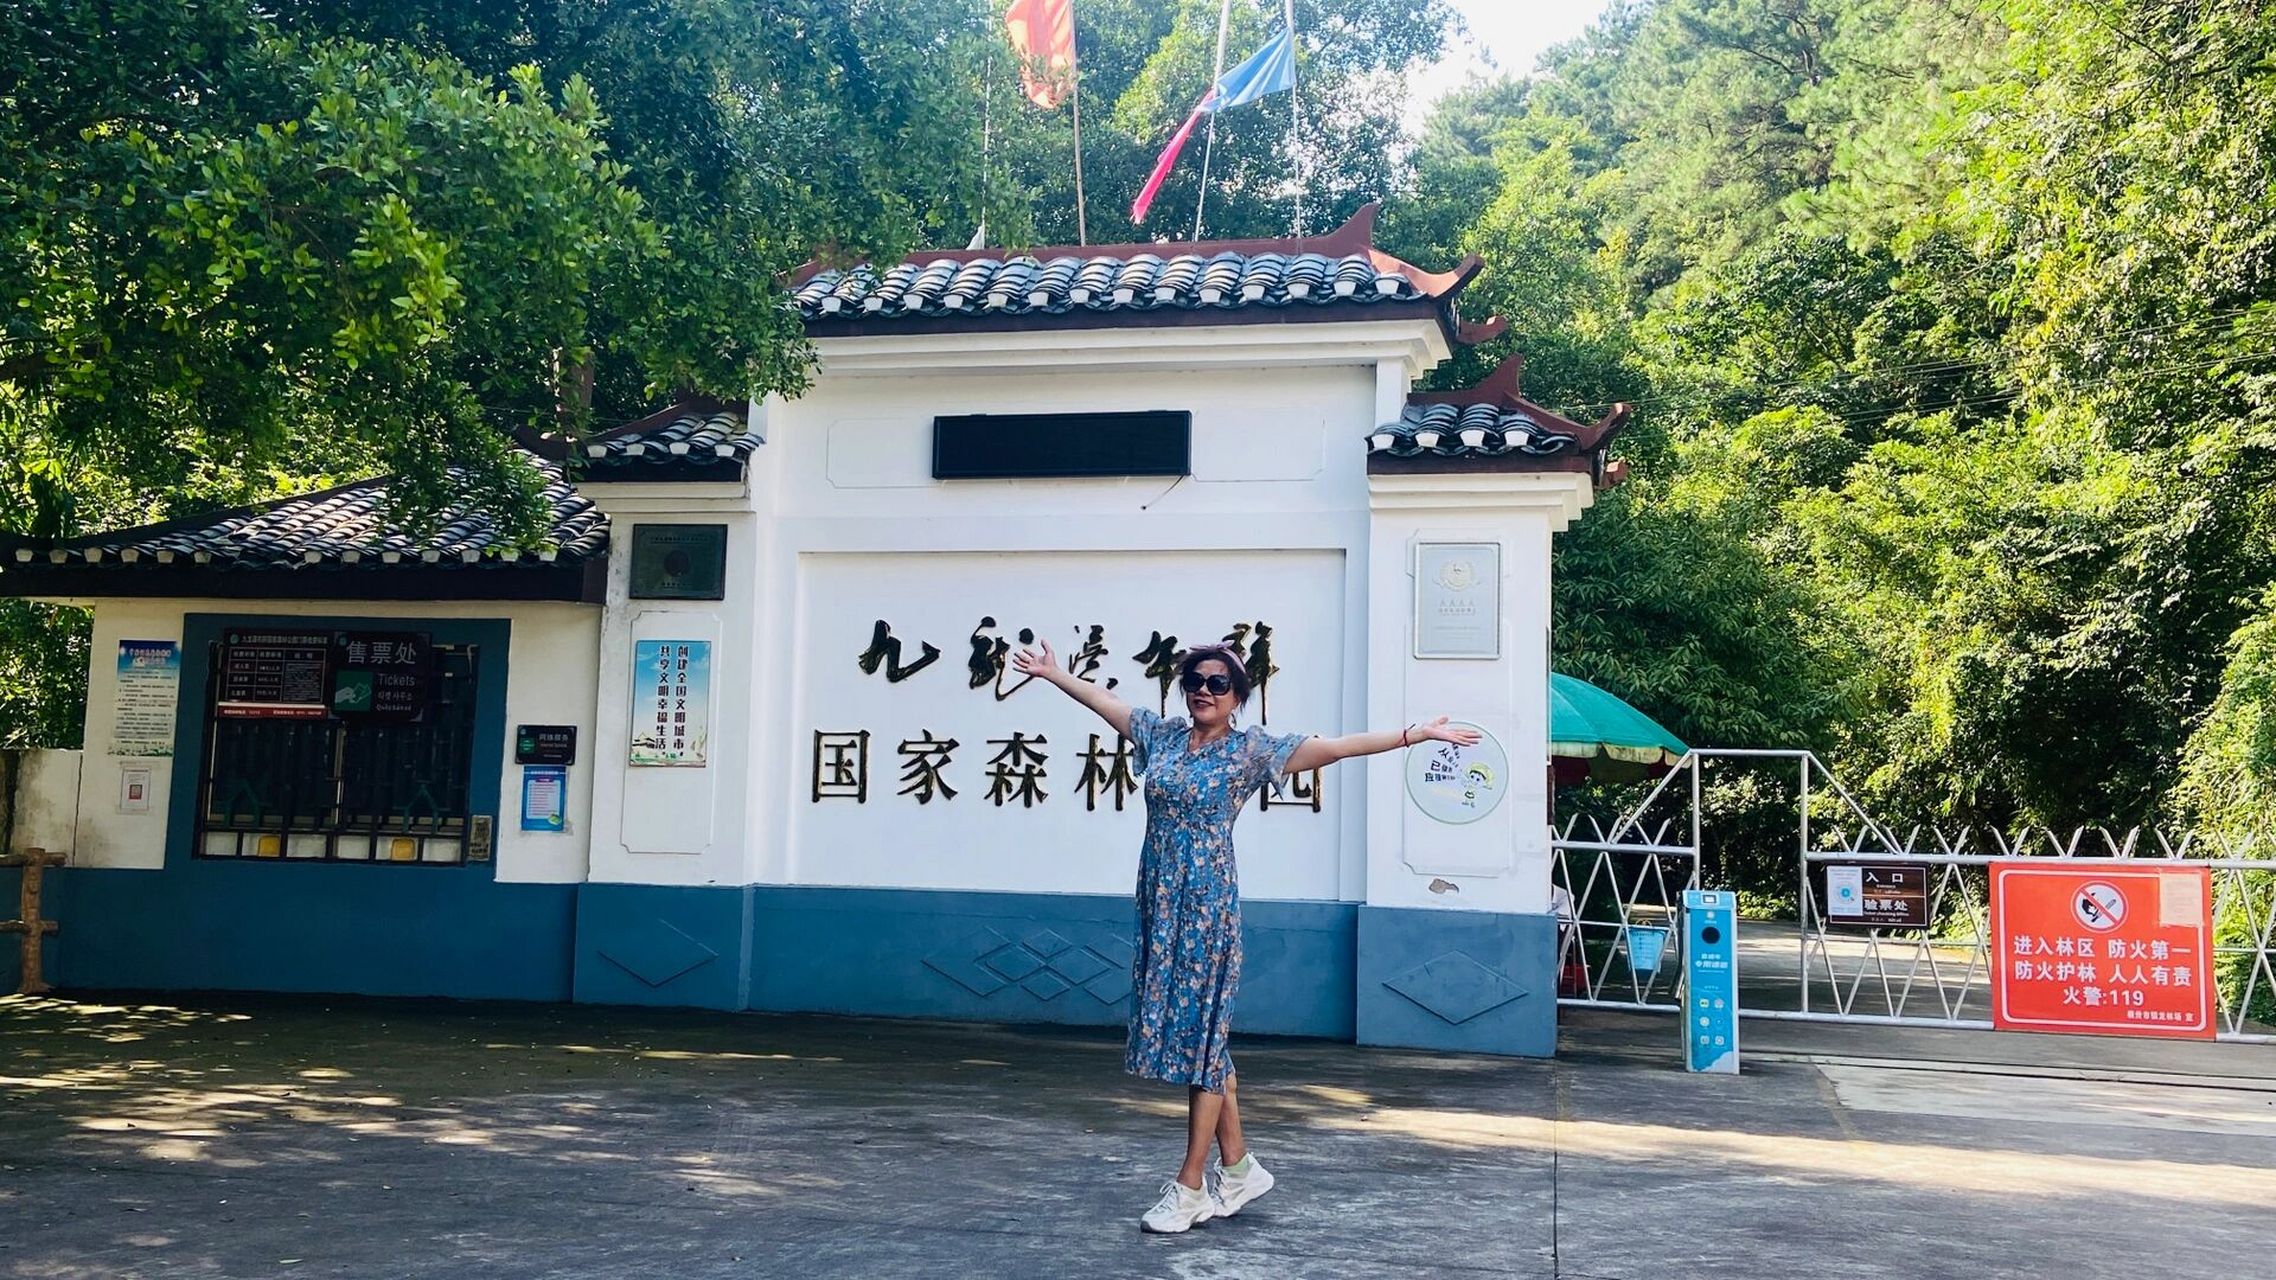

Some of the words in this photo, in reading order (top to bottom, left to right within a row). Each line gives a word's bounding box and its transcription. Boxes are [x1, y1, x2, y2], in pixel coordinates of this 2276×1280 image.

[346, 640, 417, 665] 售票处
[378, 673, 416, 687] Tickets
[1865, 872, 1904, 883] 入口
[1864, 899, 1909, 911] 验票处
[2014, 935, 2095, 957] 进入林区
[2108, 939, 2192, 961] 防火第一
[2014, 960, 2097, 983] 防火护林
[2108, 963, 2192, 987] 人人有责
